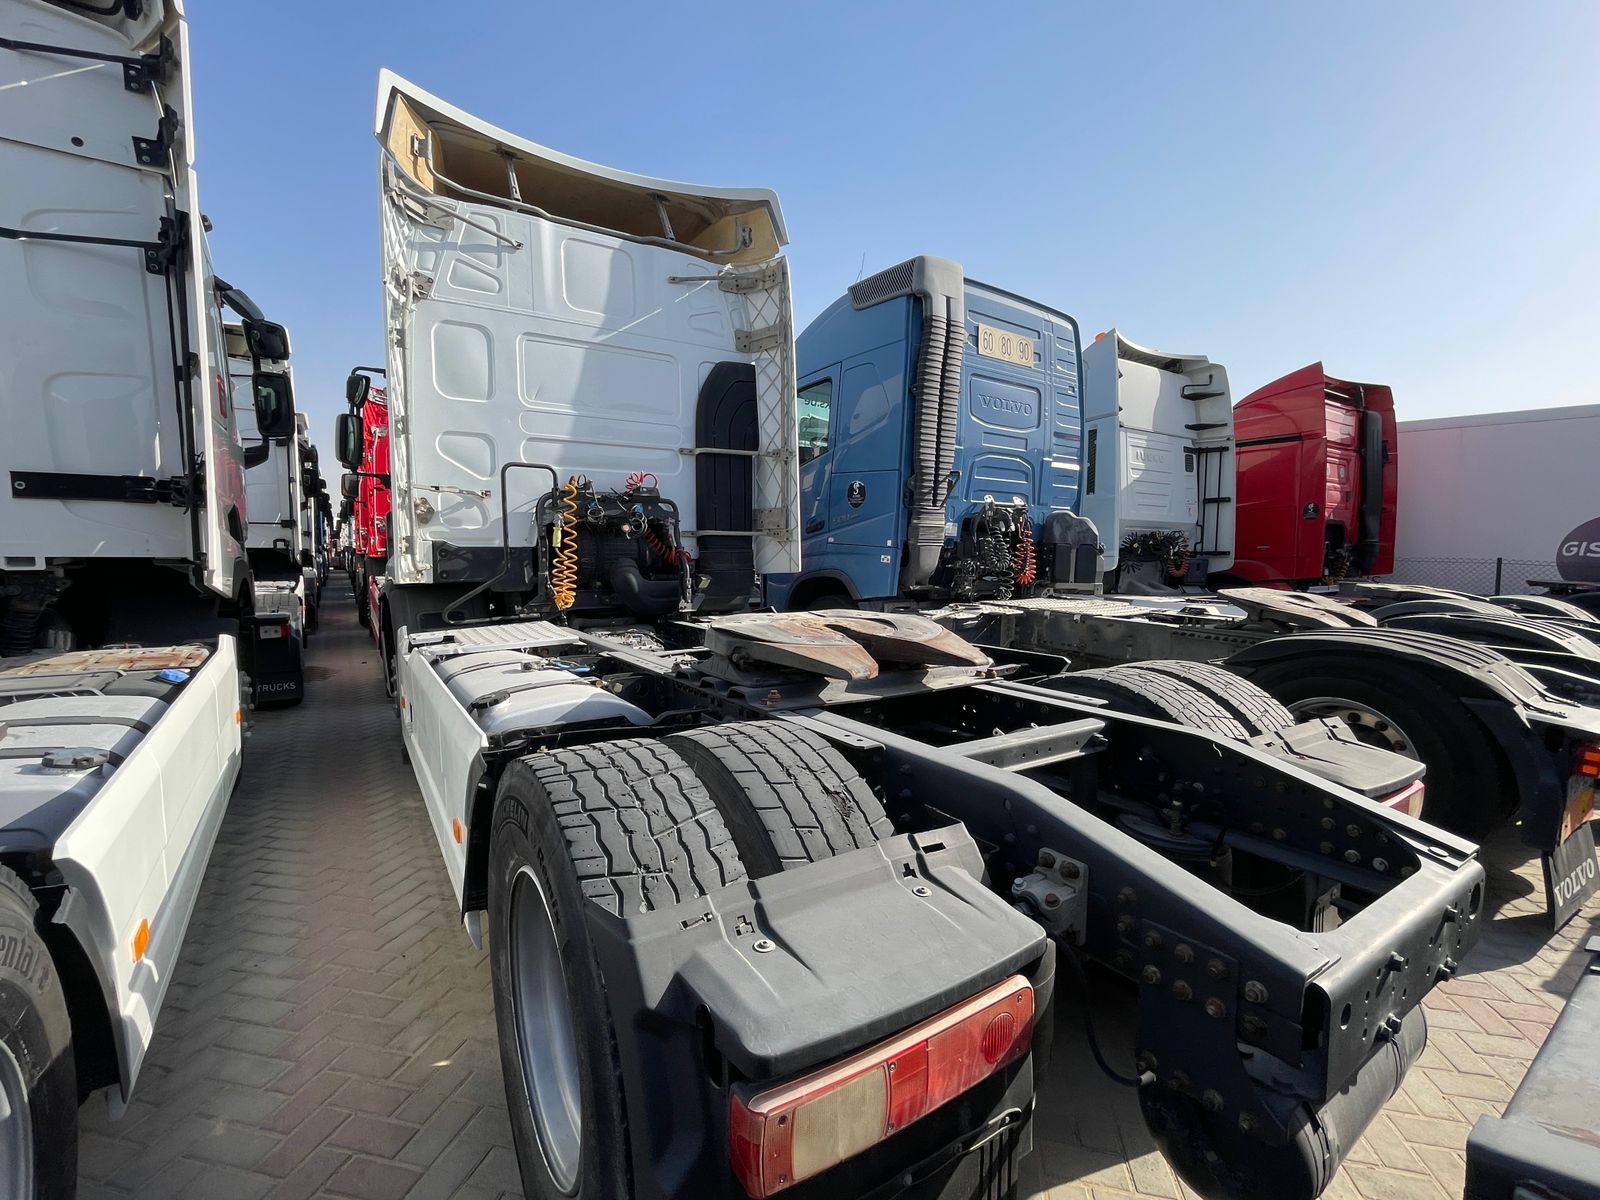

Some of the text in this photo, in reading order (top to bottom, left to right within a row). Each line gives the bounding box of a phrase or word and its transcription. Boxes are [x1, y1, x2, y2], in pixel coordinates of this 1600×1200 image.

[982, 331, 1029, 360] 60 80 90
[978, 394, 1033, 416] VOLVO
[1554, 857, 1595, 907] VOLVO
